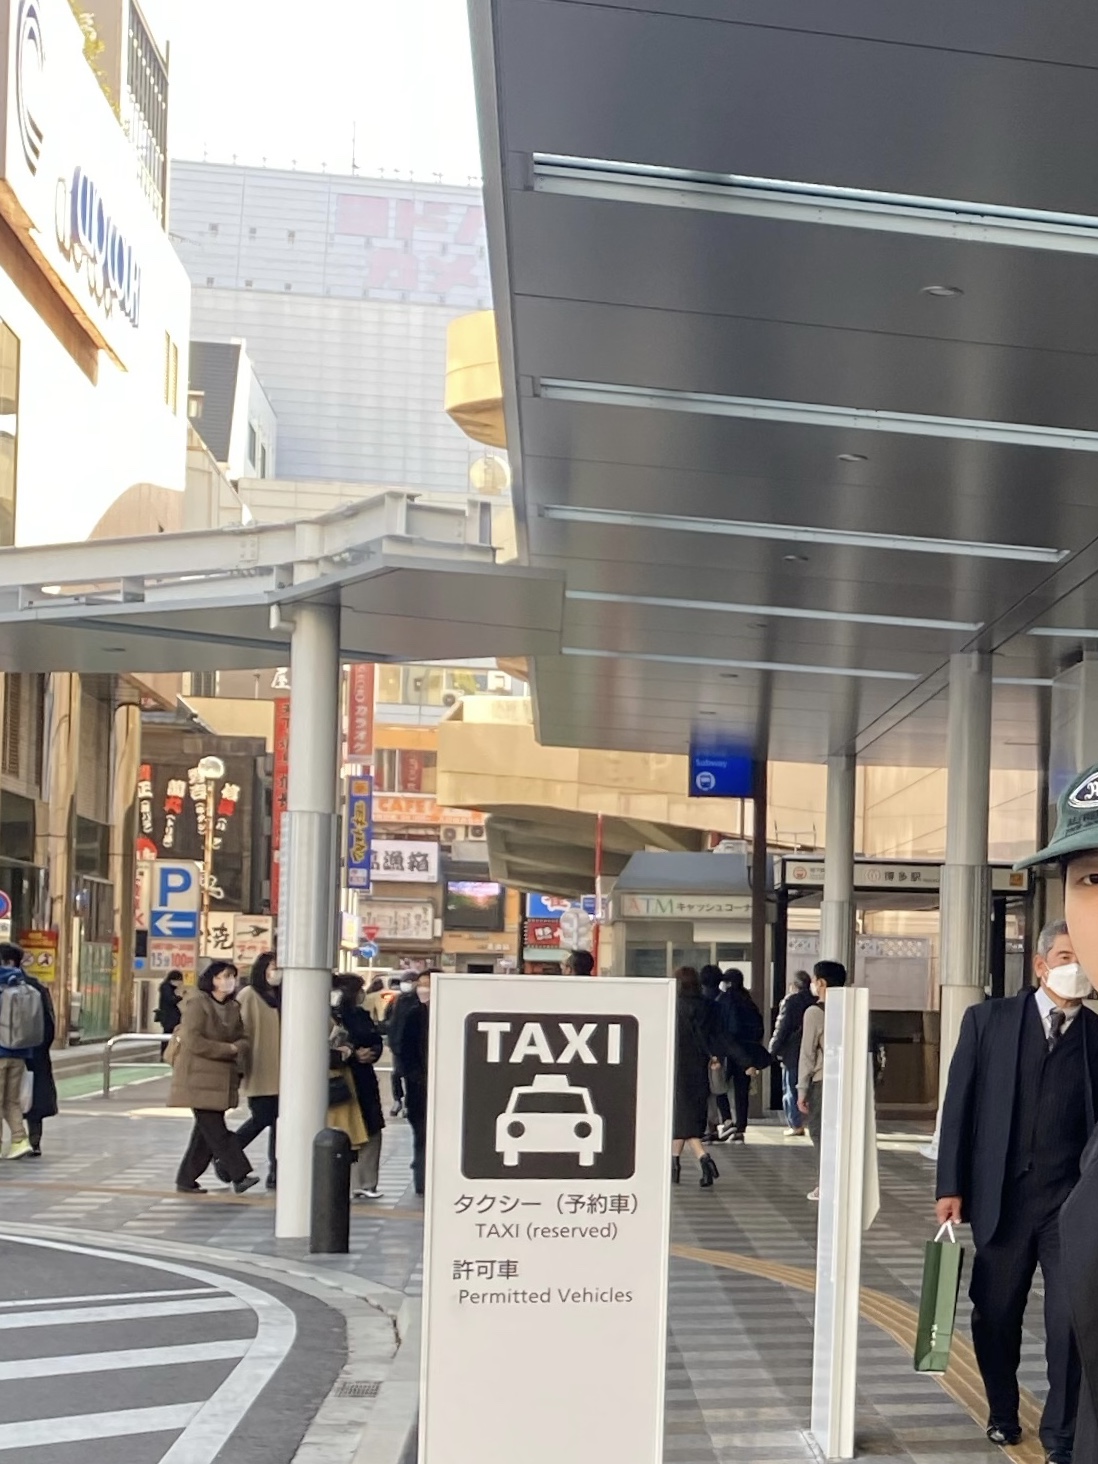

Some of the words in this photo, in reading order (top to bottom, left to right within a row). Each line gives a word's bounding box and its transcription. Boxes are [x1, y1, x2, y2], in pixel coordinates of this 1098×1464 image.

[696, 758, 728, 768] Subway
[884, 871, 922, 883] 博多駅
[159, 867, 192, 907] P
[630, 897, 674, 915] ATM
[477, 1021, 622, 1065] TAXI
[475, 1223, 520, 1238] TAXI
[526, 1222, 619, 1240] (reserved)
[452, 1259, 519, 1280] 許可車
[458, 1288, 551, 1304] Permitted
[558, 1287, 633, 1303] Vehicles
